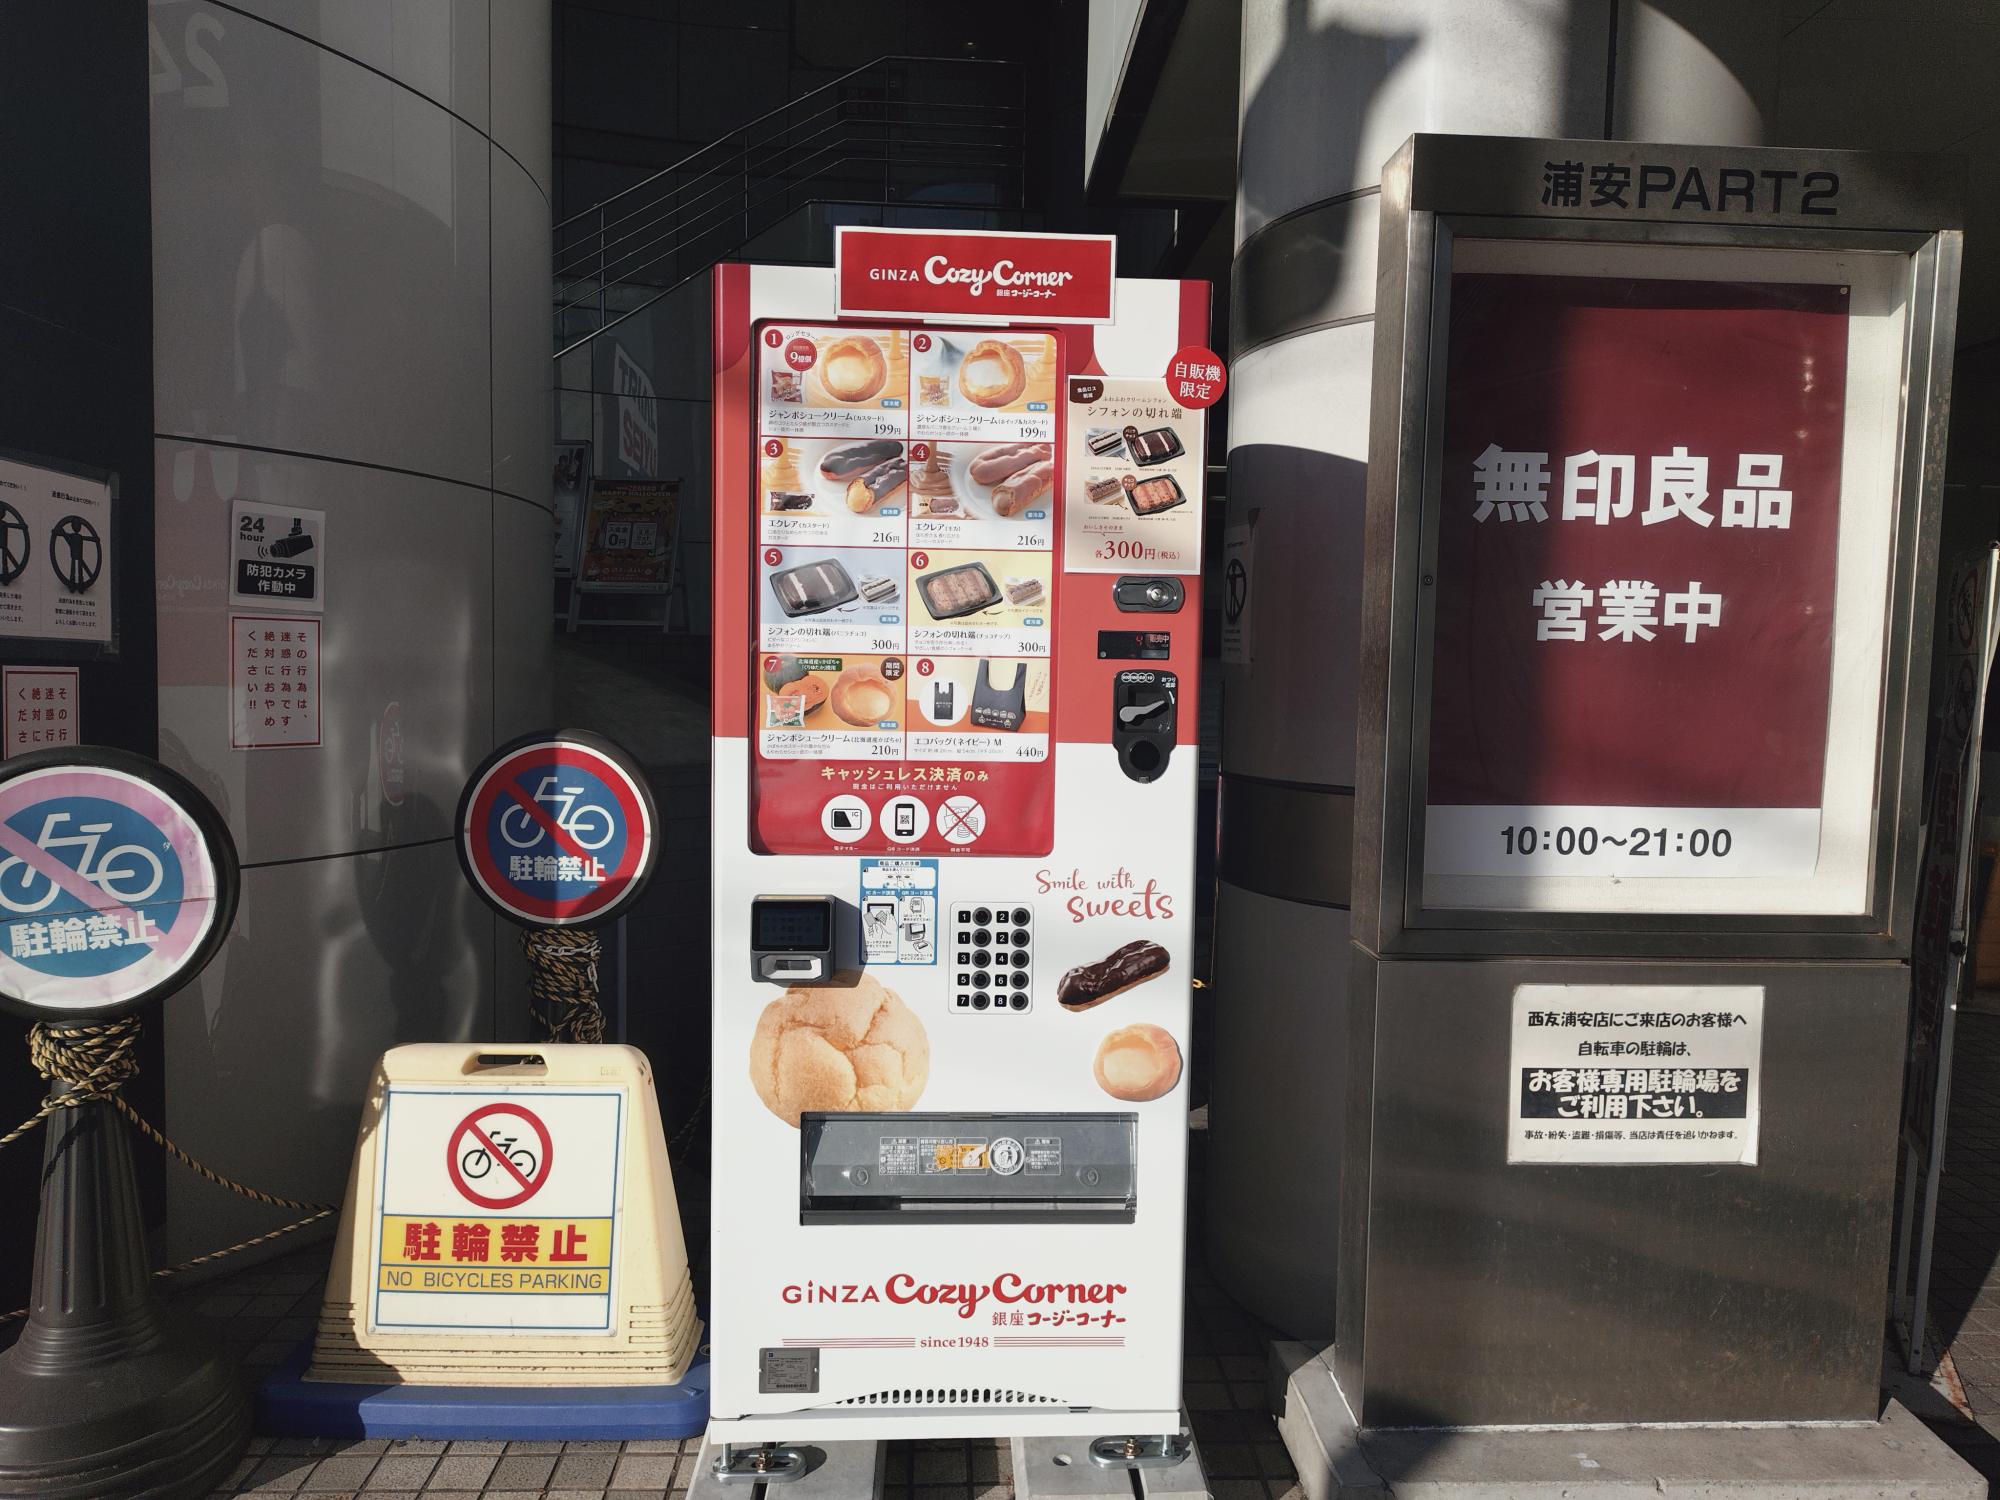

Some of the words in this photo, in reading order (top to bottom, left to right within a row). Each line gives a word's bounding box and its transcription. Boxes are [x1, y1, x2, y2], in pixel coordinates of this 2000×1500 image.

[1540, 159, 1841, 216] 浦安PART2
[869, 268, 920, 281] GINZA
[924, 256, 993, 296] Cozy
[992, 260, 1073, 287] Corner
[919, 338, 927, 350] 2
[1175, 361, 1221, 383] 自販機
[1179, 381, 1211, 400] 限定
[1087, 406, 1182, 420] シフォンの切れ端
[874, 424, 902, 435] 199円
[1019, 427, 1047, 438] 199円
[770, 443, 778, 455] 3
[917, 447, 925, 459] 4
[1472, 443, 1793, 529] 無印良品
[240, 516, 265, 533] 24
[240, 532, 264, 542] hour
[873, 532, 900, 543] 216円
[1017, 535, 1045, 547] 216円
[769, 552, 777, 565] 5
[916, 554, 925, 567] 6
[246, 563, 306, 580] 防犯カメラ
[258, 579, 296, 595] 作動中
[1532, 579, 1722, 643] 営業中
[871, 639, 900, 651] 300円
[1017, 642, 1046, 653] 300円
[769, 659, 777, 672] 7
[921, 661, 930, 674] 8
[264, 631, 276, 728] 絶対におやめ
[296, 631, 308, 721] その行為は、
[871, 745, 900, 756] 210円
[1016, 747, 1044, 758] 440円
[821, 766, 989, 783] キャッシュレス決済のみ
[852, 783, 958, 791] 現金はご利用いただけません
[508, 855, 606, 882] 駐輪禁止
[1035, 868, 1088, 894] Smile
[1097, 866, 1135, 890] with
[10, 910, 159, 959] 駐輪禁止
[1528, 1011, 1747, 1028] 西友浦安店にご来店のお客様へ
[1577, 1040, 1692, 1057] 自転車の駐輪は、
[1528, 1069, 1742, 1094] お客様専用駐輪場を
[1557, 1094, 1704, 1118] ご利用下さい。
[402, 1222, 588, 1262] 駐輪禁止
[386, 1270, 413, 1287] NO
[423, 1271, 513, 1288] BICYCLES
[519, 1273, 602, 1289] PARKING
[885, 1273, 991, 1319] Cozy
[991, 1272, 1127, 1304] Corner
